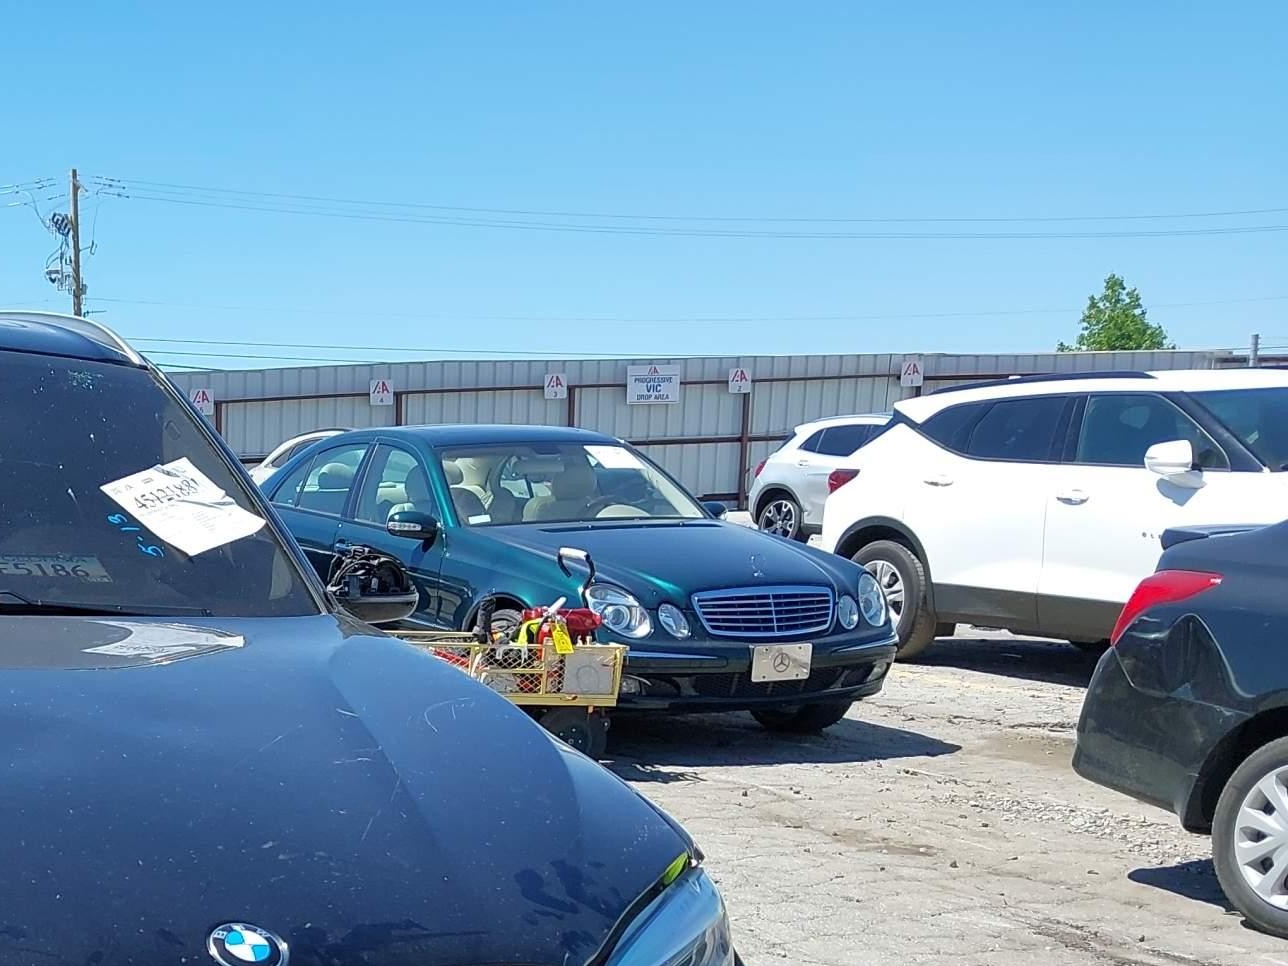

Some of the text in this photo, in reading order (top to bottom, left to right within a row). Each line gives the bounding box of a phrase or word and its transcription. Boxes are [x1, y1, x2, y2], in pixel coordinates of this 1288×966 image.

[633, 376, 673, 384] PROGRESSIVE
[646, 383, 662, 393] VIC
[636, 393, 670, 401] DROP AREA
